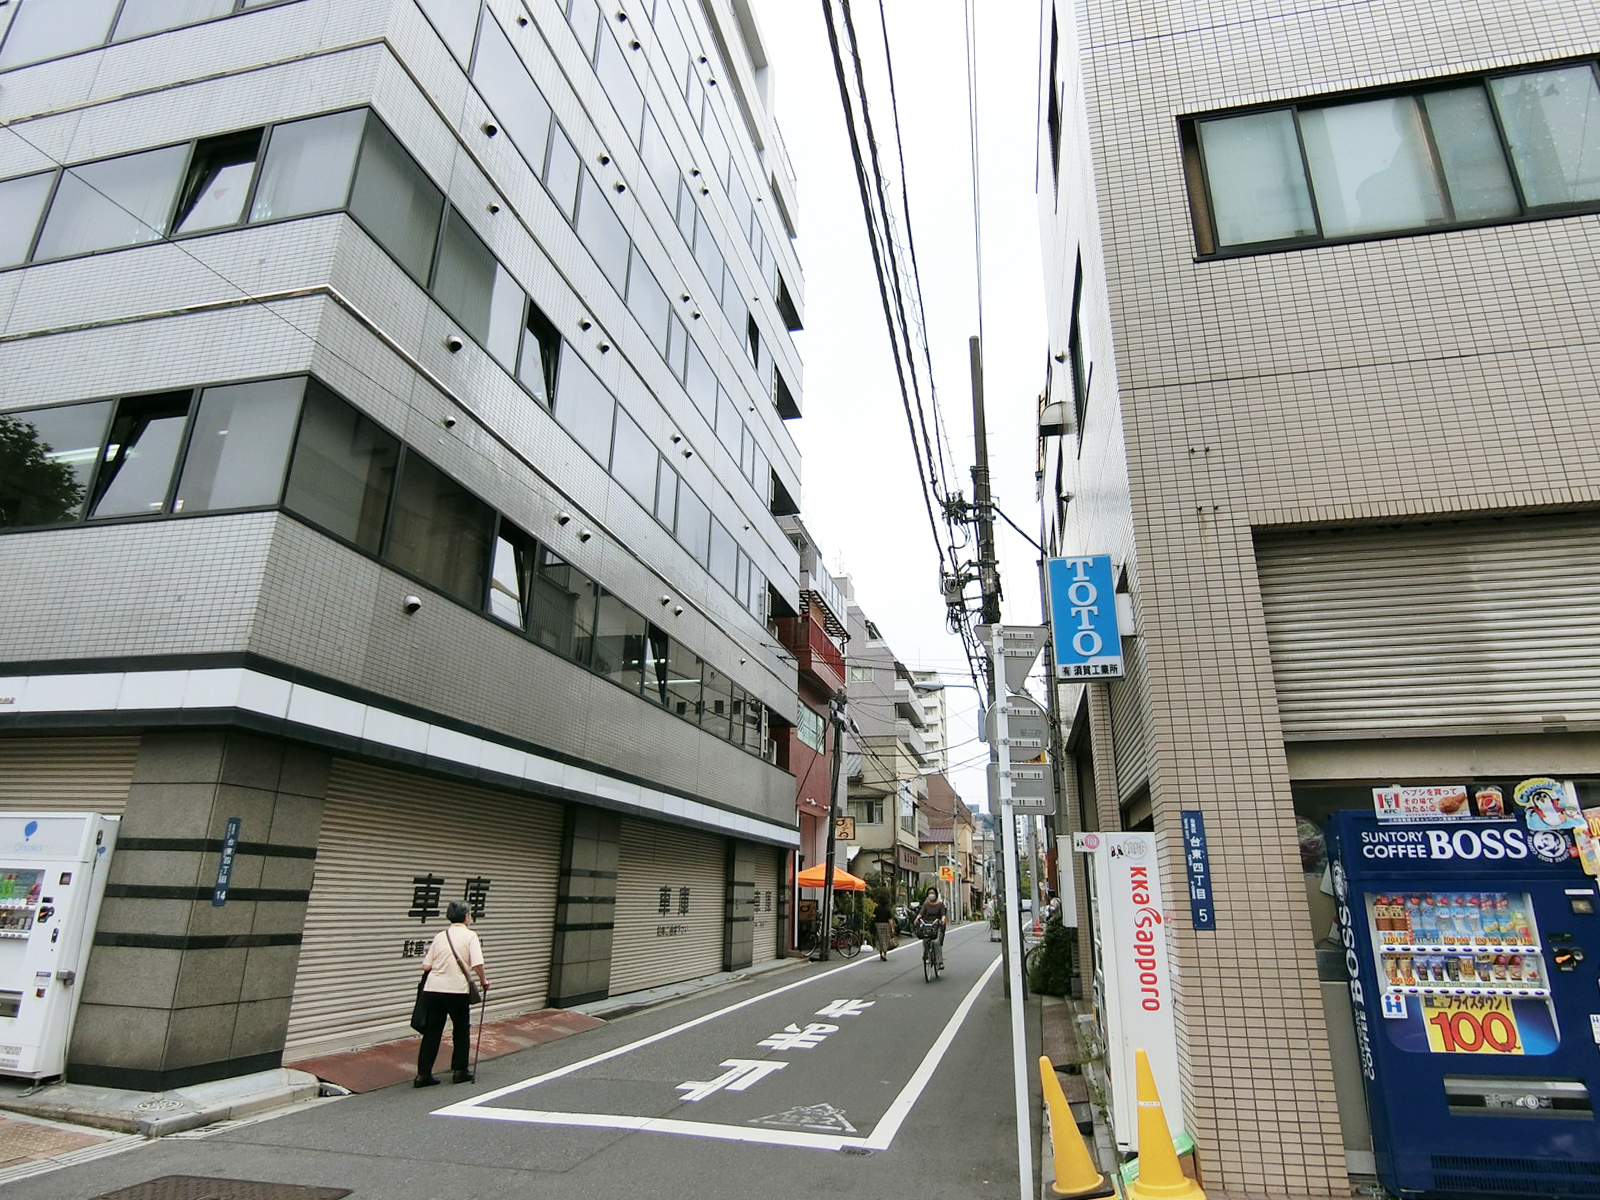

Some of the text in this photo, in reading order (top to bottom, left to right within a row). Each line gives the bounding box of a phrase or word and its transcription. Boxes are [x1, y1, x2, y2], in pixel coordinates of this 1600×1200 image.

[1066, 558, 1102, 656] TOTO
[1074, 664, 1118, 677] 須賀工業所
[1402, 788, 1457, 796] ペプシを買って
[1361, 831, 1424, 843] SUNTORY
[1363, 844, 1428, 859] COFFEE
[1426, 828, 1528, 860] BOSS
[1190, 836, 1206, 899] 台東四丁目
[216, 890, 226, 900] 14
[408, 873, 491, 923] 車庫
[658, 884, 691, 917] 車庫
[1199, 908, 1208, 922] 5
[1338, 905, 1365, 1007] BOSS
[1429, 1011, 1521, 1053] 100
[674, 999, 876, 1102] 止まれ
